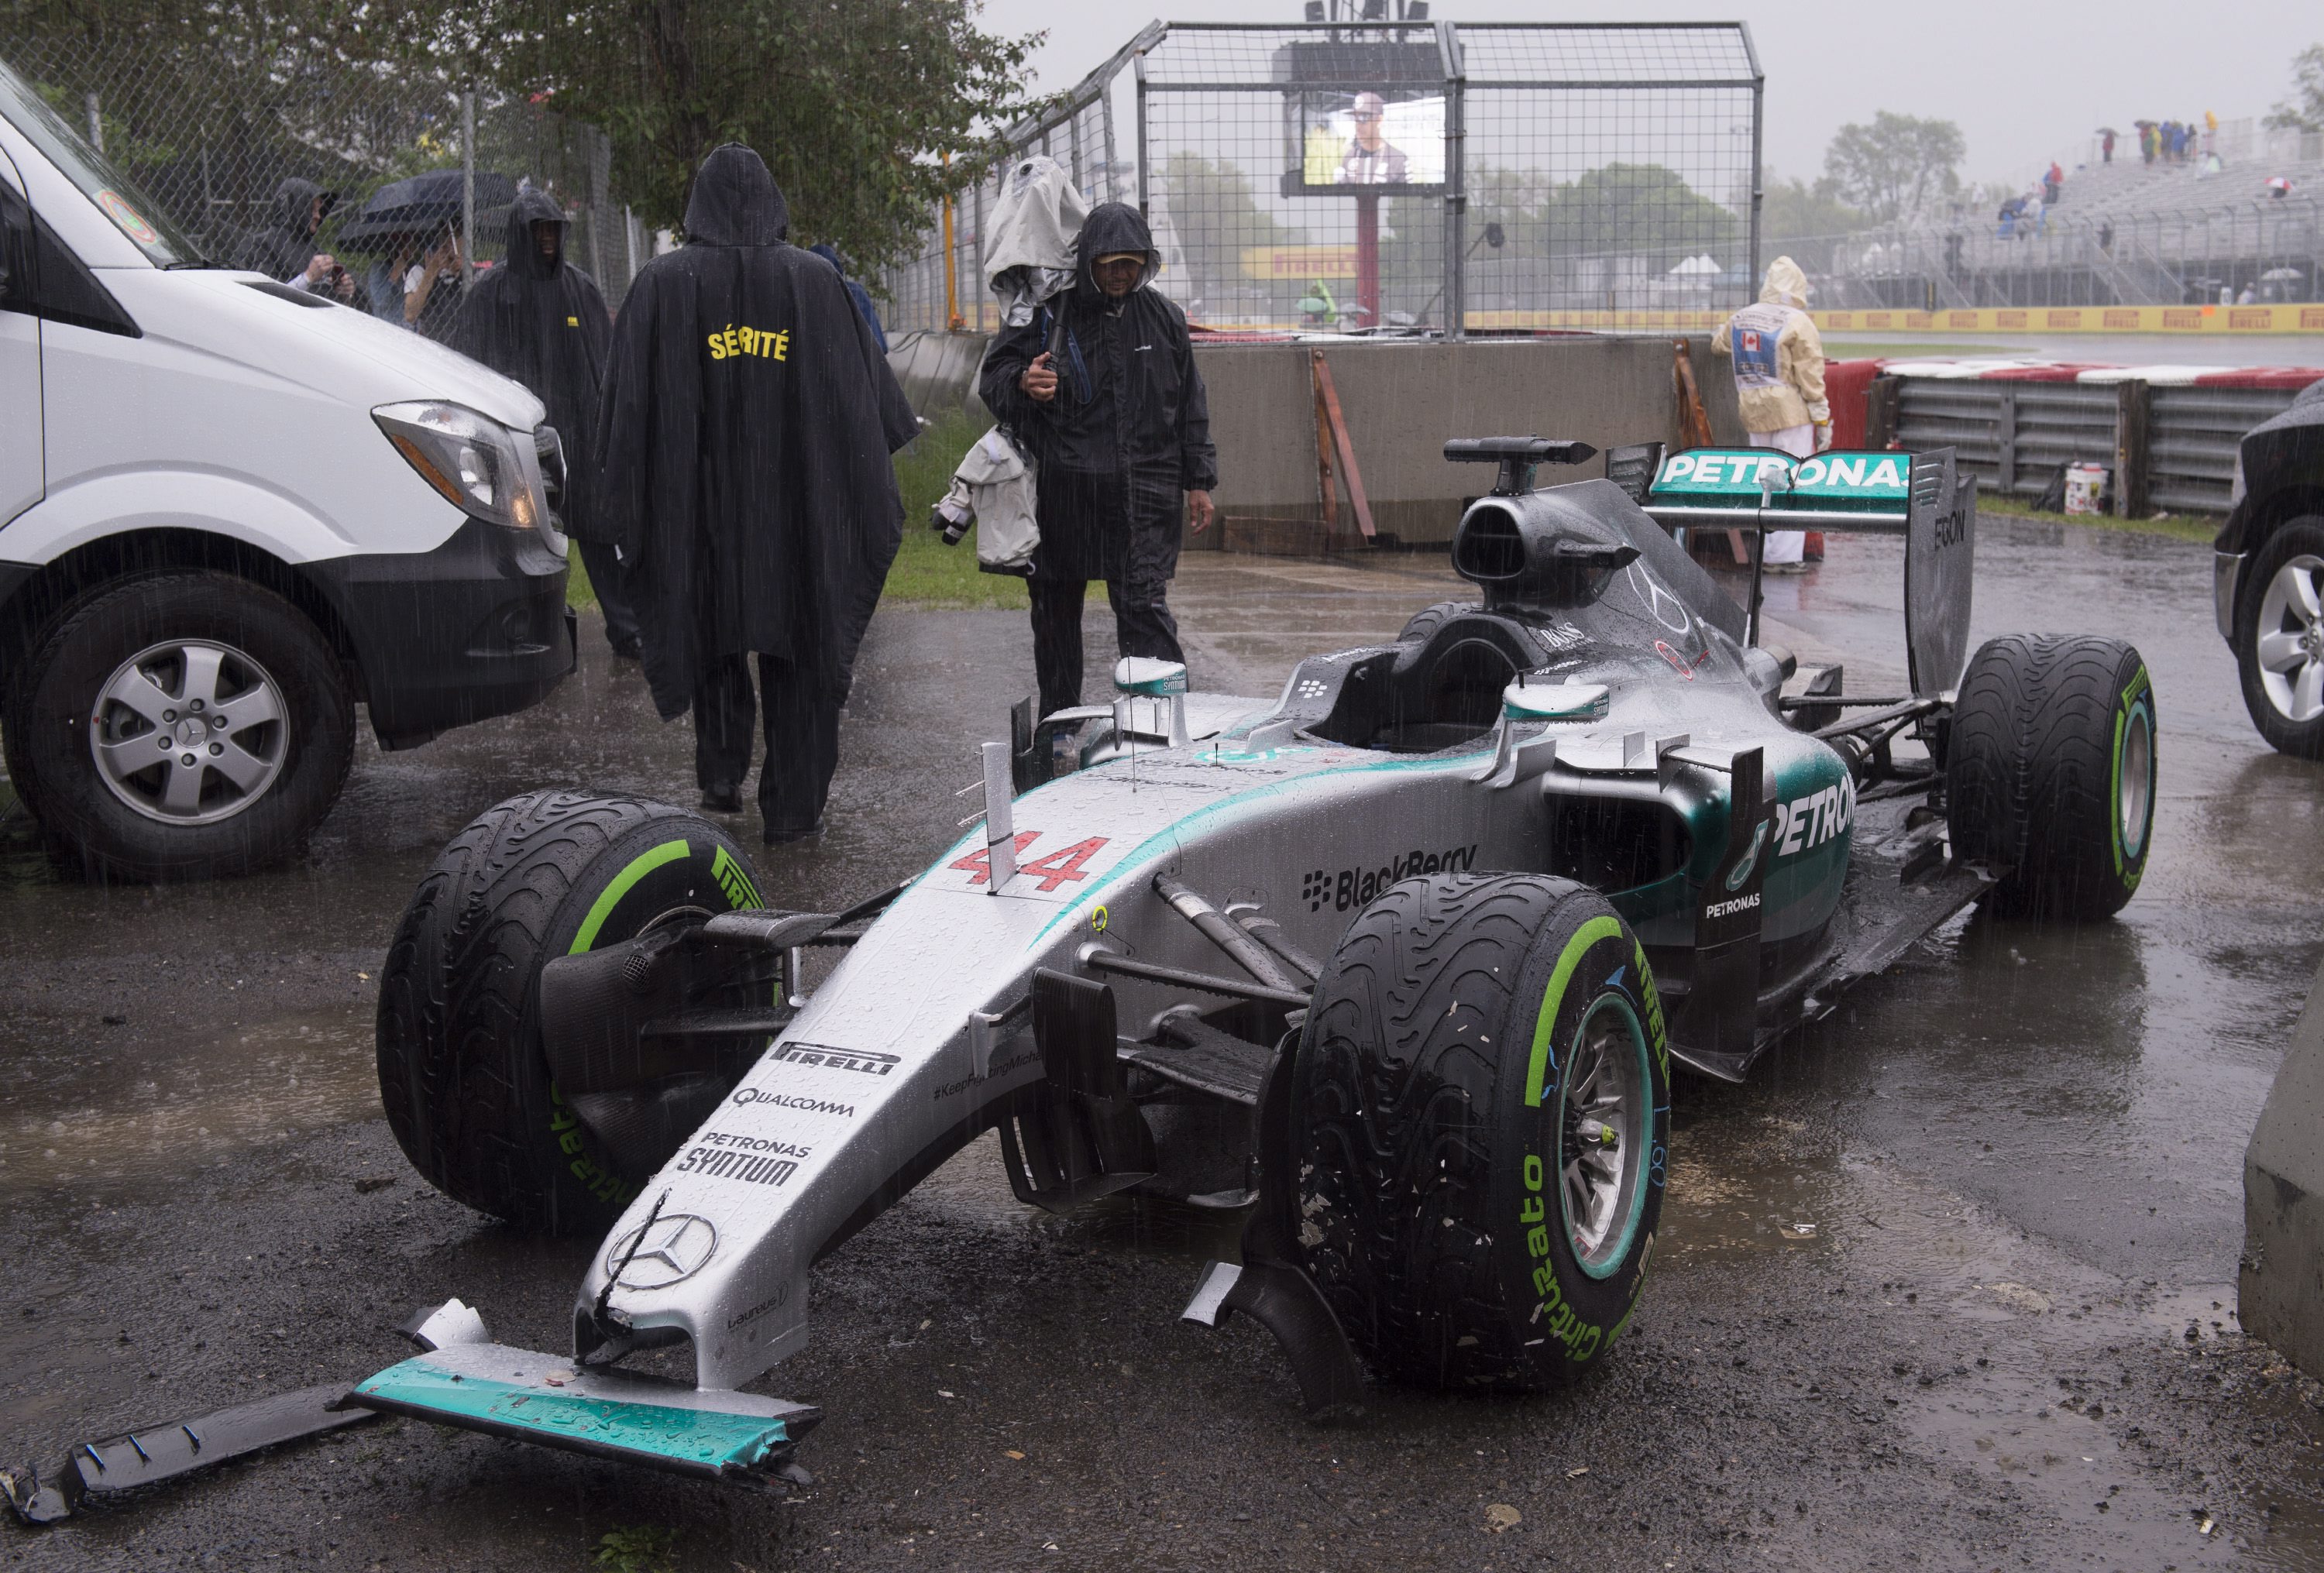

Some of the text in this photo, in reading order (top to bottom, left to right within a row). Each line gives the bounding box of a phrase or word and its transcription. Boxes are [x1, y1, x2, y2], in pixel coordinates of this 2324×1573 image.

[2163, 310, 2202, 329] PIRELLI
[2229, 309, 2271, 329] PIRELLI
[1539, 622, 1585, 647] BOSS
[947, 830, 1111, 892] 44
[1706, 893, 1760, 919] PETRONAS
[768, 1041, 902, 1075] PIRELLI
[733, 1087, 854, 1118] QUALCOMM
[700, 1132, 813, 1159] PETRONAS
[676, 1147, 799, 1187] SYNTIUM
